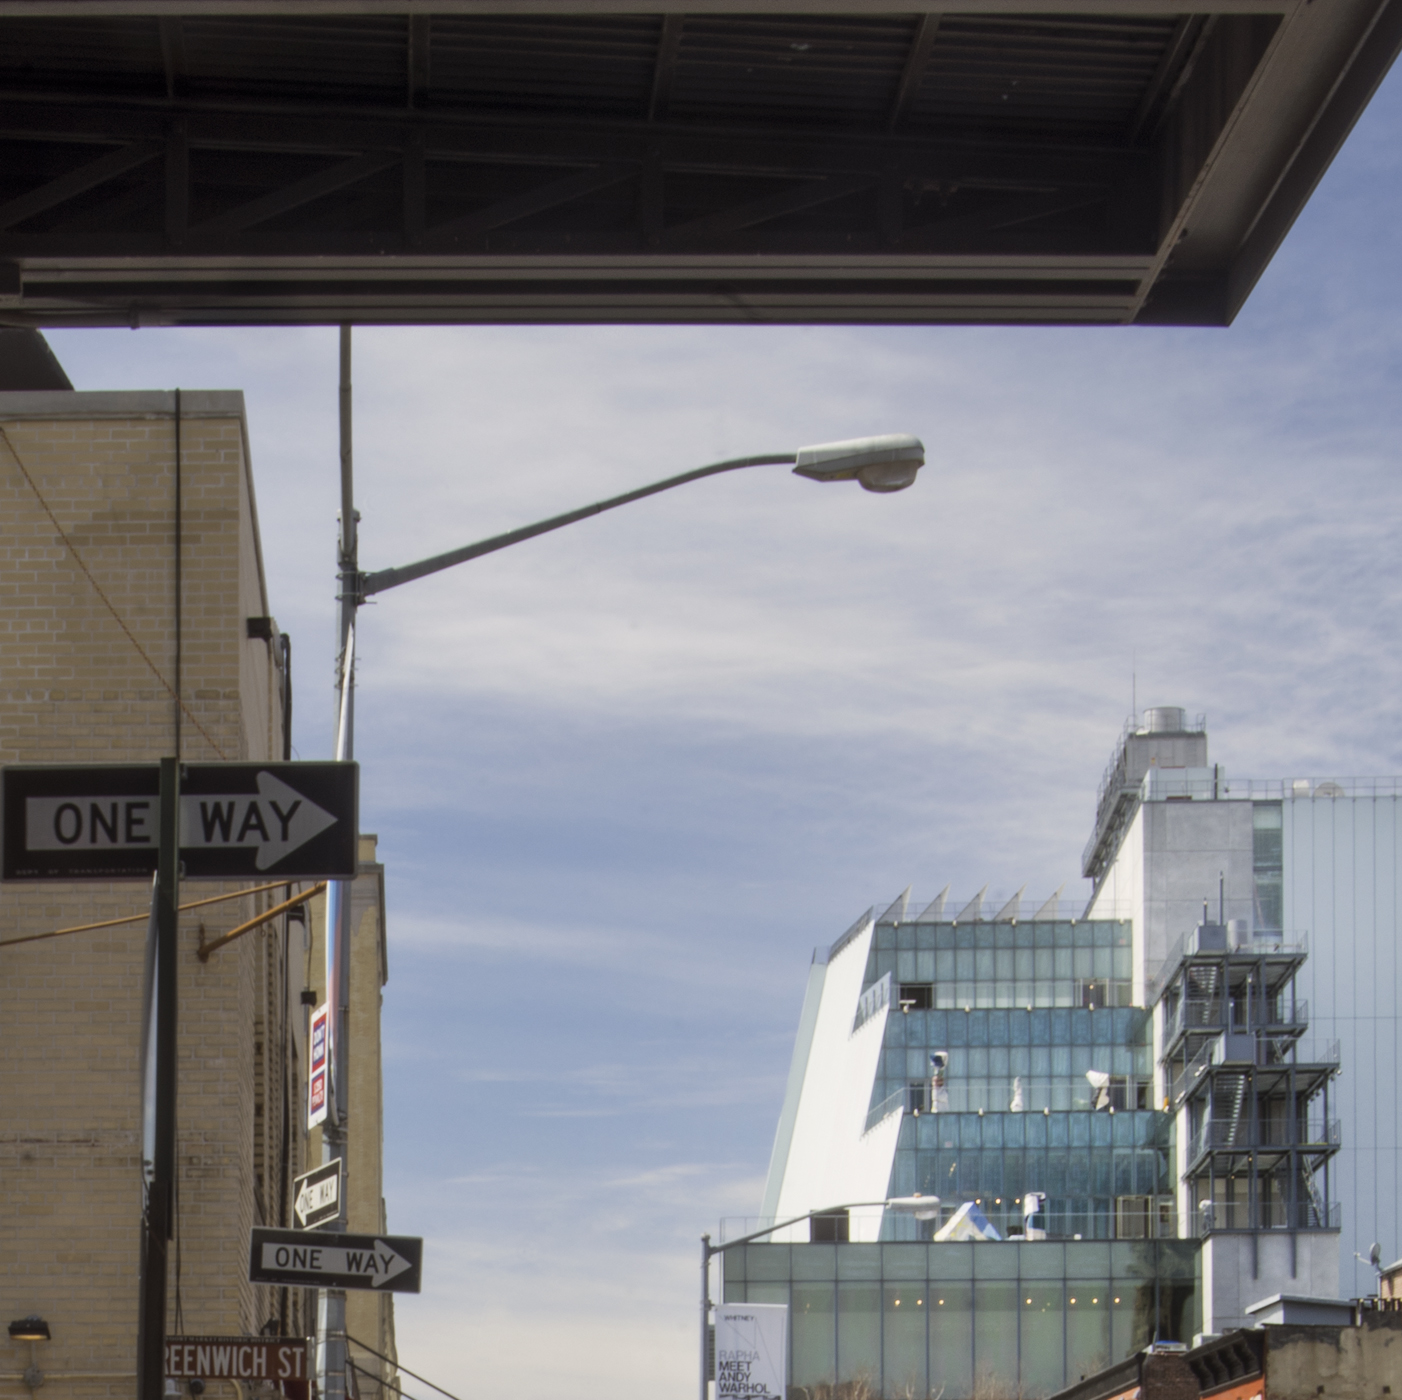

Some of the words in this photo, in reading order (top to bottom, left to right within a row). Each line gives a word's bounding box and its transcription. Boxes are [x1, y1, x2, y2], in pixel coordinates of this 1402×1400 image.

[54, 802, 151, 845] ONE
[200, 801, 302, 843] WAY
[300, 1189, 314, 1214] ONE
[320, 1178, 335, 1206] WAY
[275, 1246, 323, 1270] ONE
[346, 1251, 395, 1275] WAY
[724, 1314, 755, 1322] WHITNEY
[719, 1350, 761, 1361] RAPHA
[278, 1346, 305, 1378] ST
[719, 1361, 752, 1372] MEET
[719, 1372, 752, 1382] ANDY
[719, 1383, 770, 1394] WARHOL
